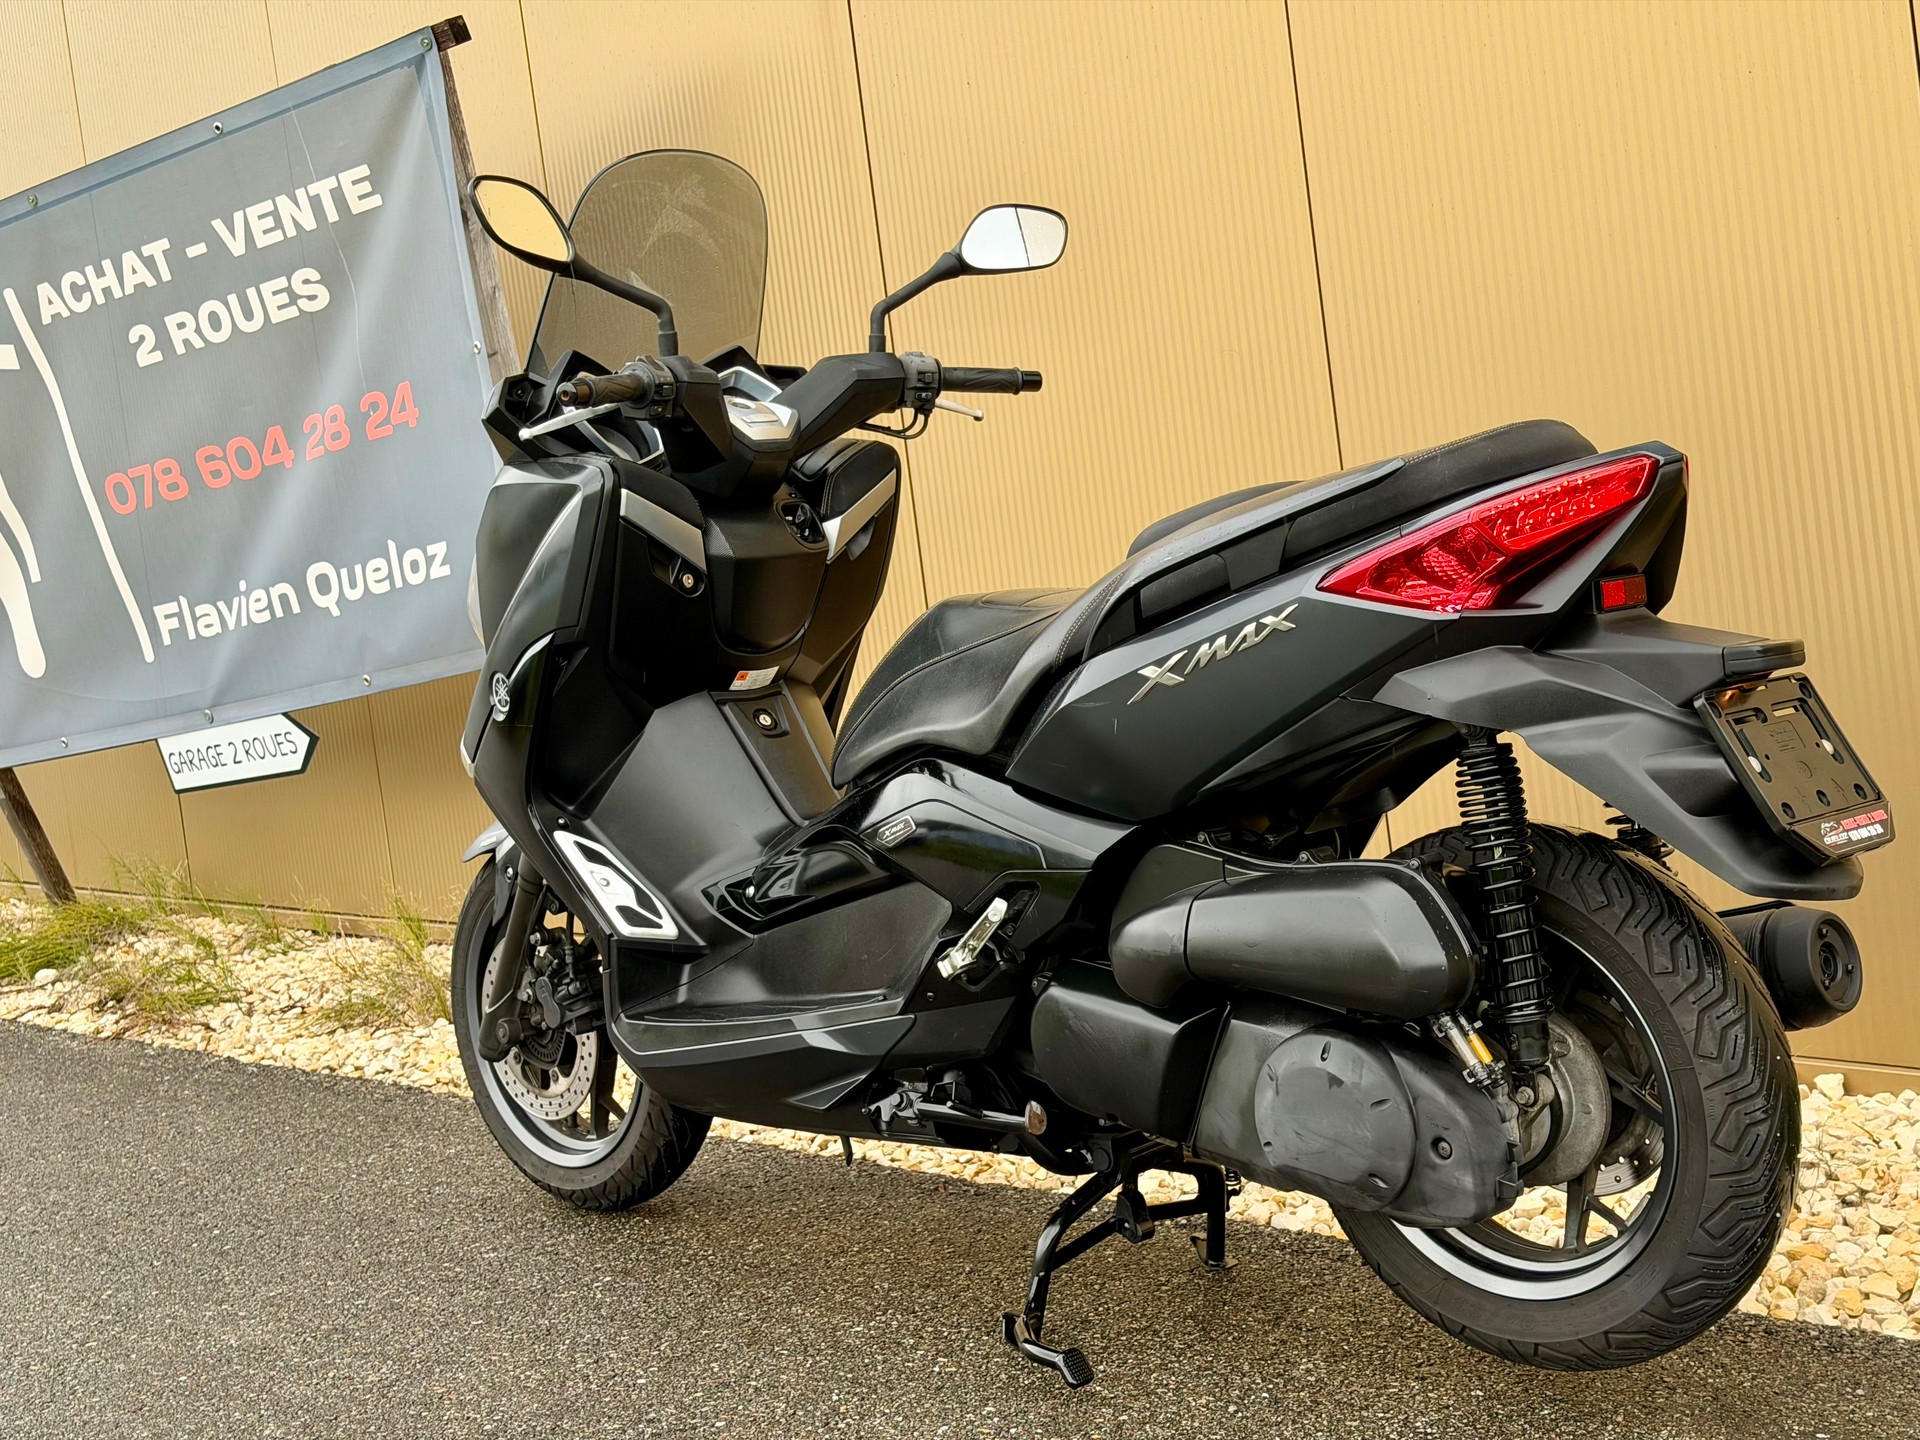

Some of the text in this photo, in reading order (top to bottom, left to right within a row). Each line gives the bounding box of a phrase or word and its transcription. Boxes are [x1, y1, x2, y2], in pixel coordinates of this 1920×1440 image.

[36, 163, 383, 325] ACHAT - VENTE
[128, 267, 331, 368] 2 ROUES
[105, 381, 420, 515] 078 604 28 24
[153, 539, 451, 647] Flavien Queloz
[1127, 603, 1299, 705] XMAX
[168, 731, 298, 774] GARAGE 2 ROUES
